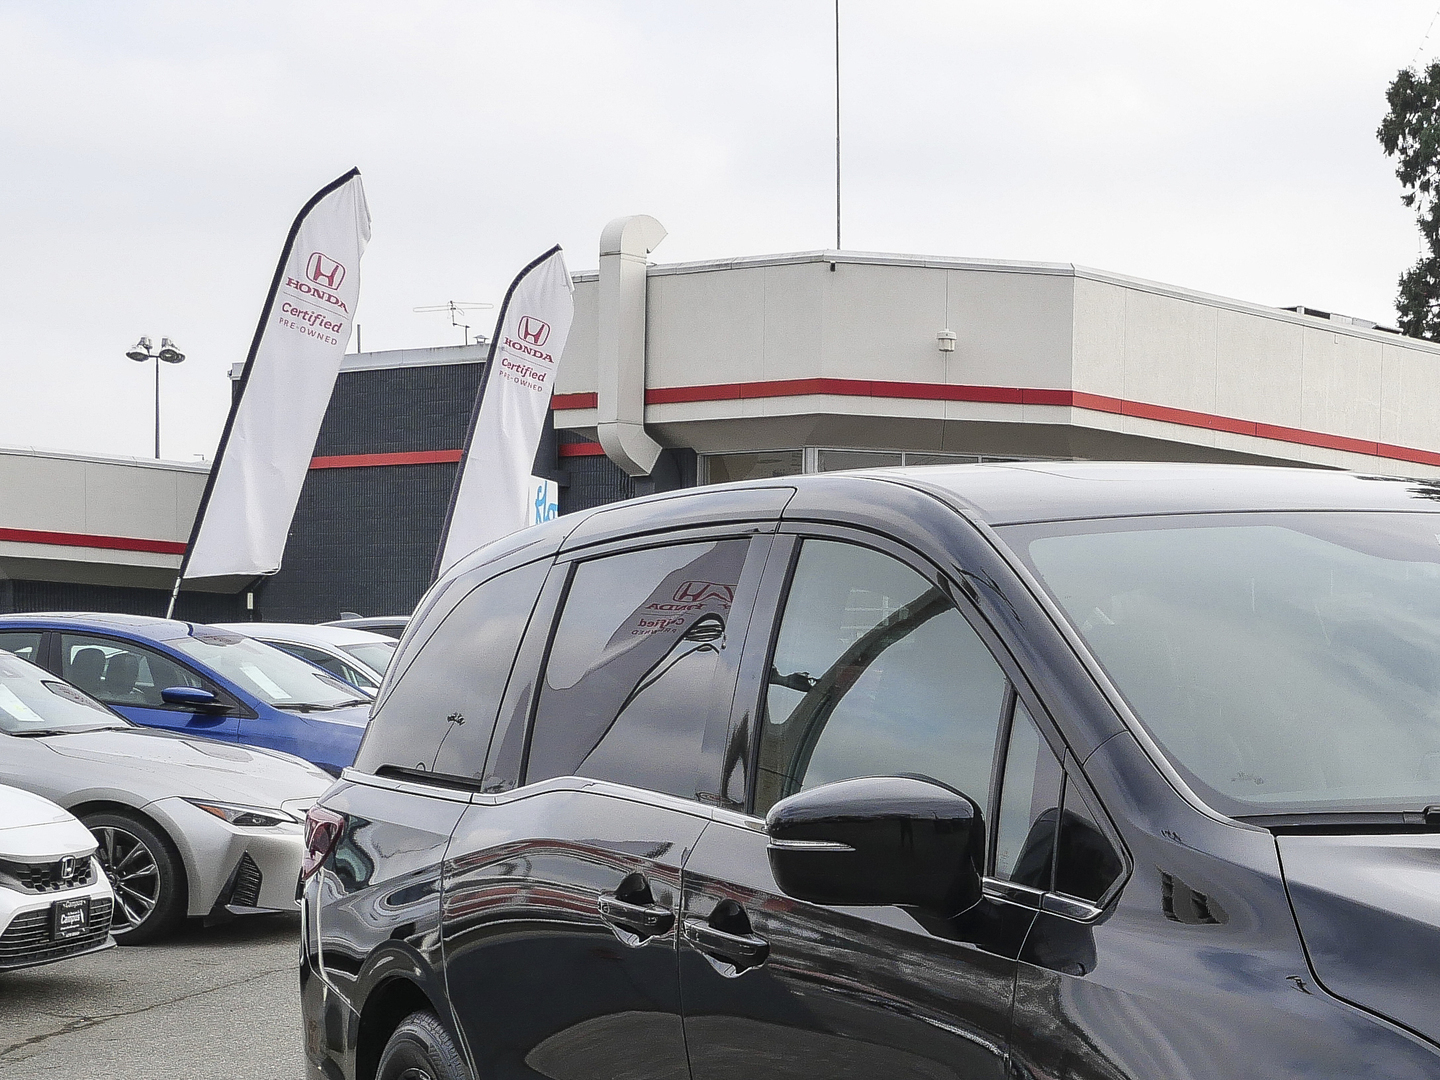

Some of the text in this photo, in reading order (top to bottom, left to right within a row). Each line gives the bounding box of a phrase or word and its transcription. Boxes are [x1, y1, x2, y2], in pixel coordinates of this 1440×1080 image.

[285, 276, 349, 314] HONDA
[278, 317, 338, 346] PRE-OWNED
[281, 302, 343, 334] Certified
[503, 336, 555, 364] HONDA
[499, 370, 543, 392] PRE-OWNED
[501, 358, 547, 383] Certified
